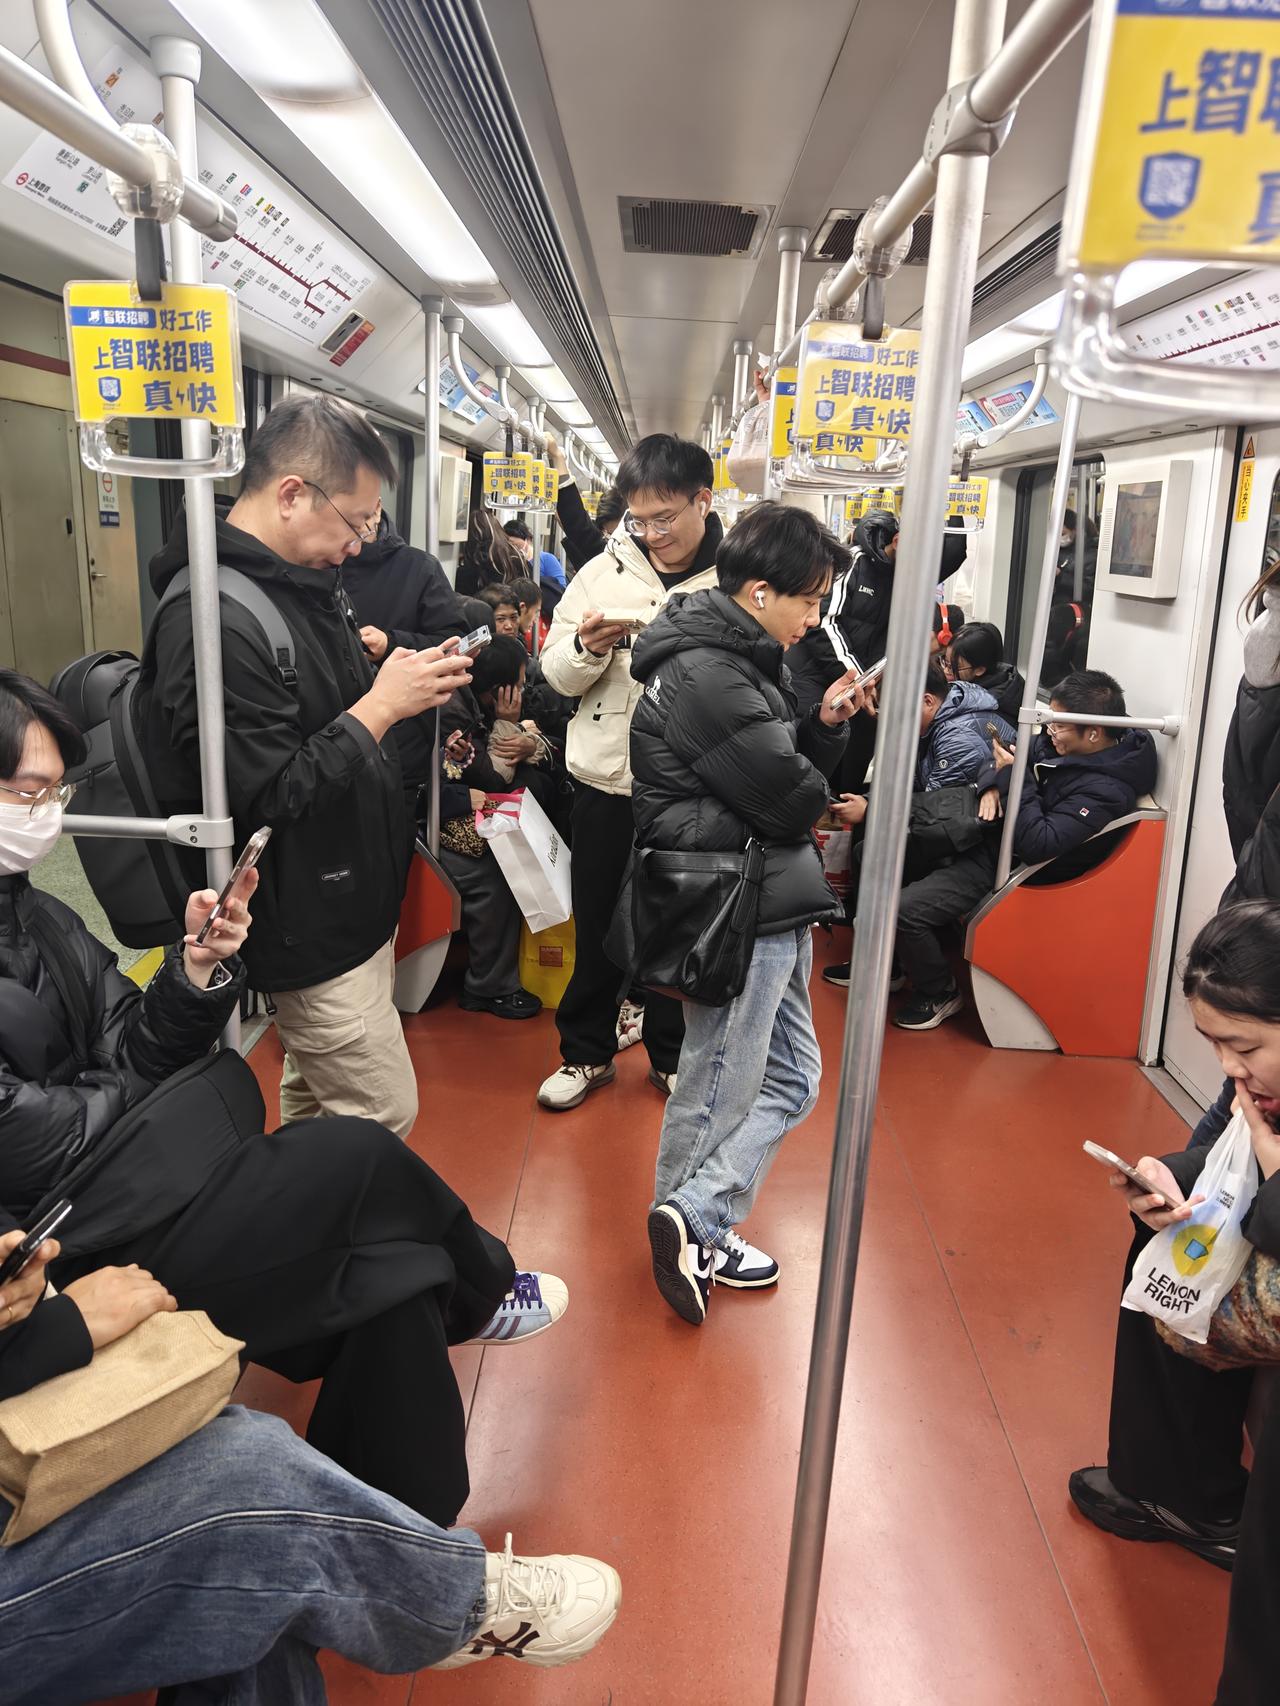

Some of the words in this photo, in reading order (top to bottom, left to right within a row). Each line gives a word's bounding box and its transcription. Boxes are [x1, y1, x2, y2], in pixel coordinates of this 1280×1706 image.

[103, 308, 150, 326] 智联招聘
[160, 309, 212, 333] 好工作
[93, 338, 214, 374] 上智联招聘
[876, 347, 919, 369] 好工作
[814, 368, 916, 402] 上智联招聘
[1143, 1282, 1194, 1314] RIGHT
[1147, 1267, 1201, 1302] LEMON
